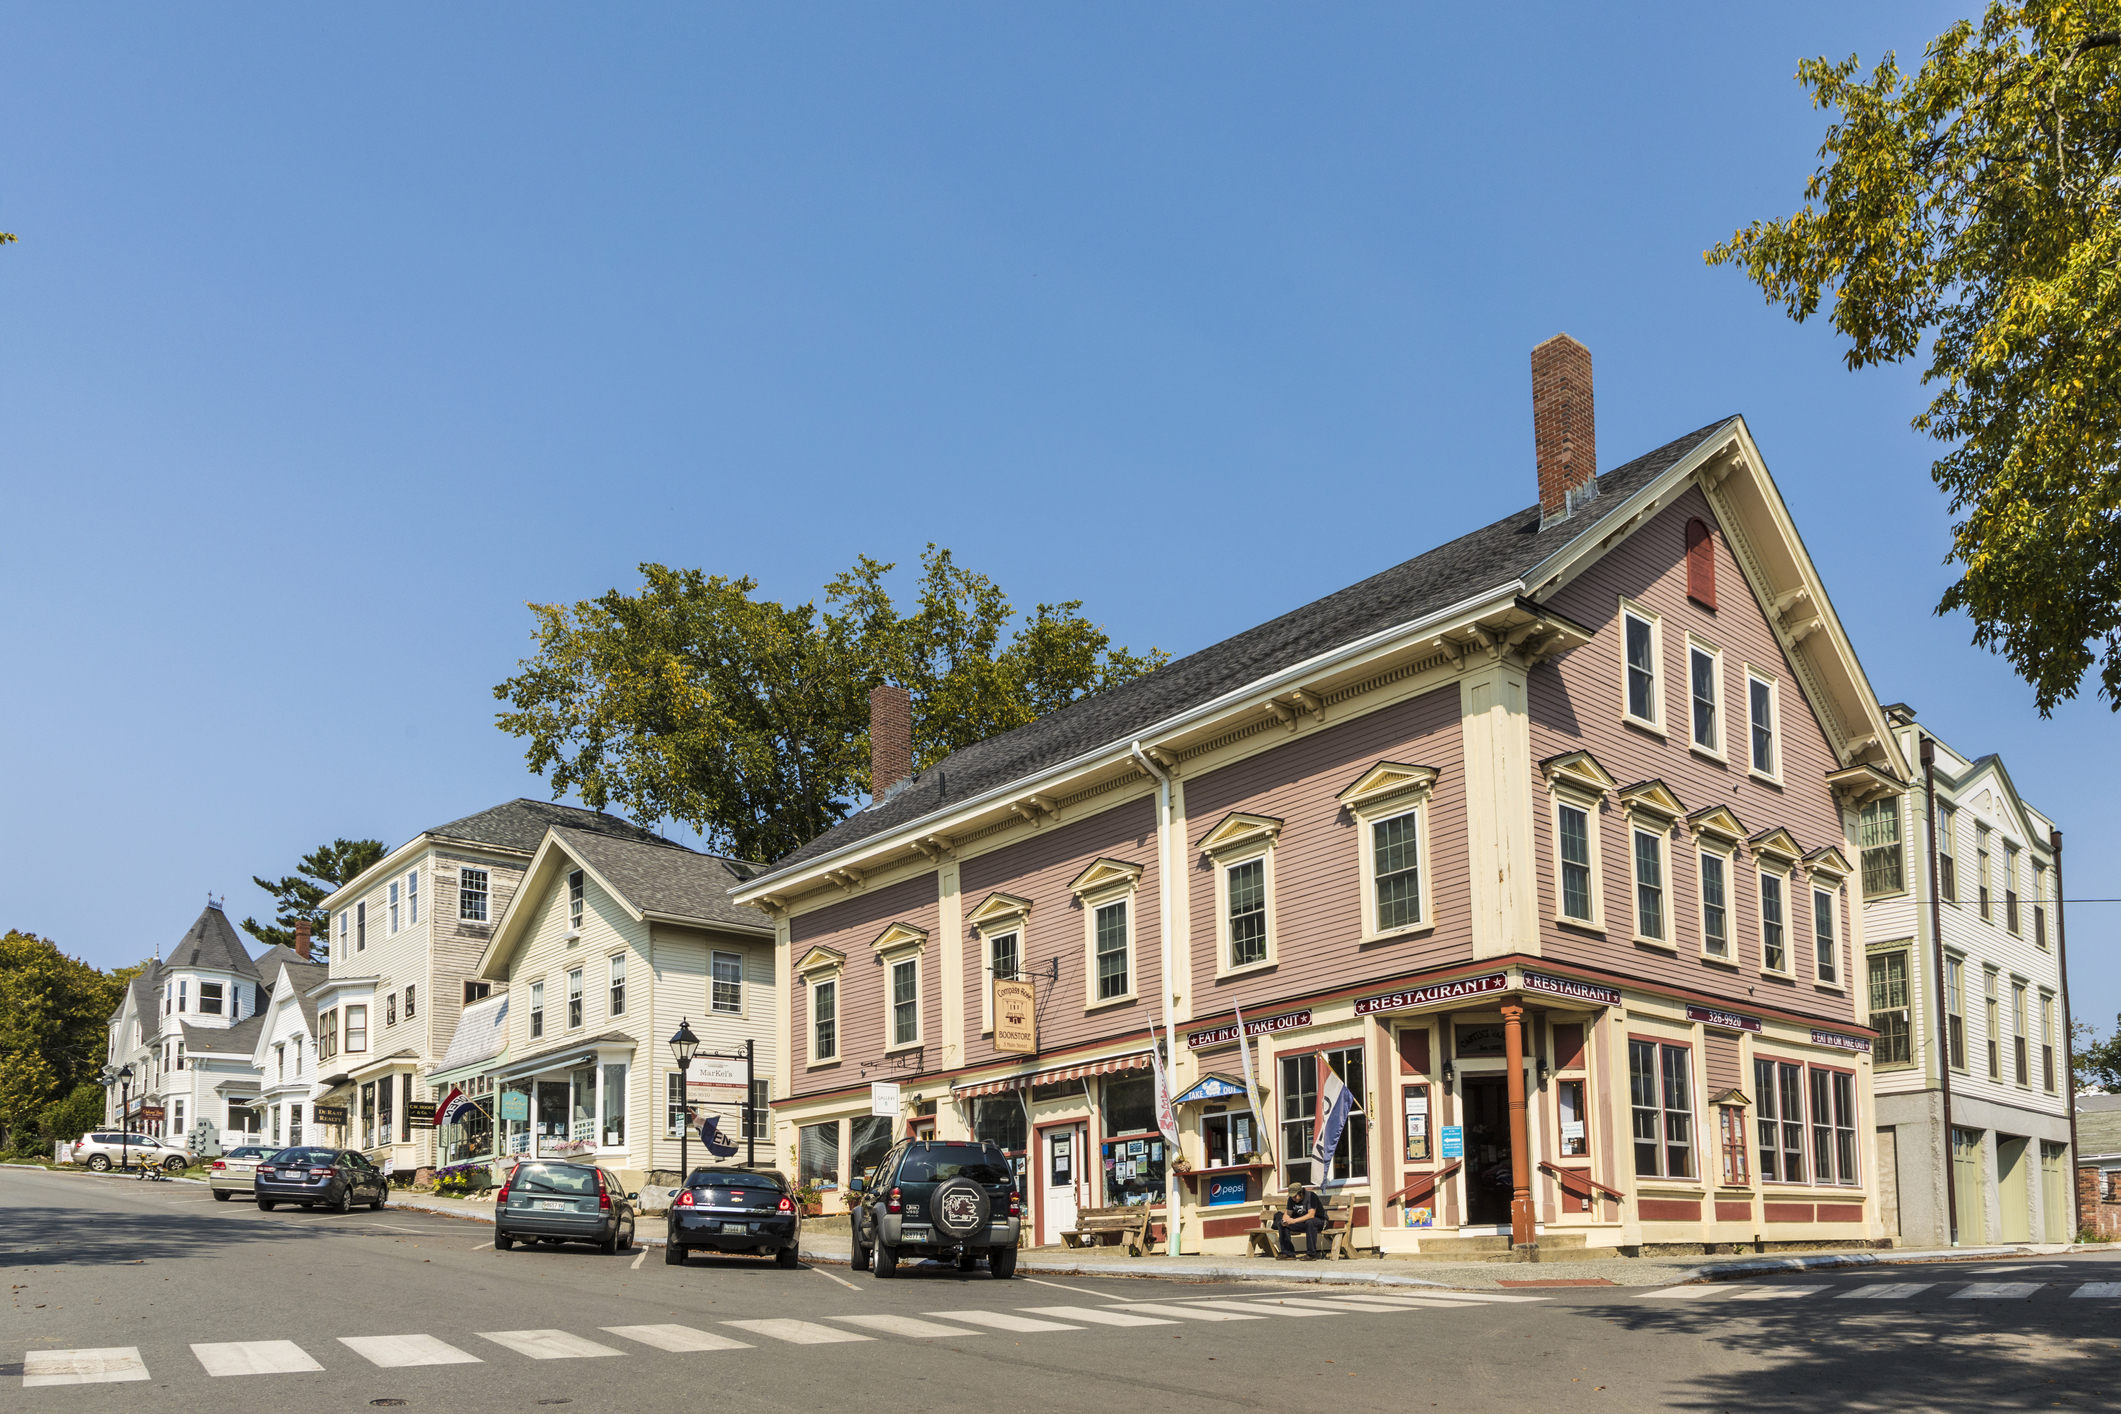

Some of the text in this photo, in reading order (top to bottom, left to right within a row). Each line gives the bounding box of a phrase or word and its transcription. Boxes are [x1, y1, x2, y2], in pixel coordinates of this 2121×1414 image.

[997, 987, 1032, 1001] Compass Rose
[1369, 978, 1489, 1010] RESTAURANT
[1534, 976, 1612, 1001] RESTAURANT
[1708, 1011, 1742, 1027] 326-9920
[998, 1030, 1031, 1040] BOOKSTORE
[1198, 1015, 1299, 1044] EAT IN O TAKE OUT
[1816, 1033, 1826, 1044] EAT
[1834, 1036, 1842, 1046] OR
[1843, 1037, 1854, 1048] TAKE
[1855, 1039, 1865, 1049] OUT
[1188, 1086, 1236, 1100] TAKE OUT
[1222, 1183, 1244, 1195] pepsi
